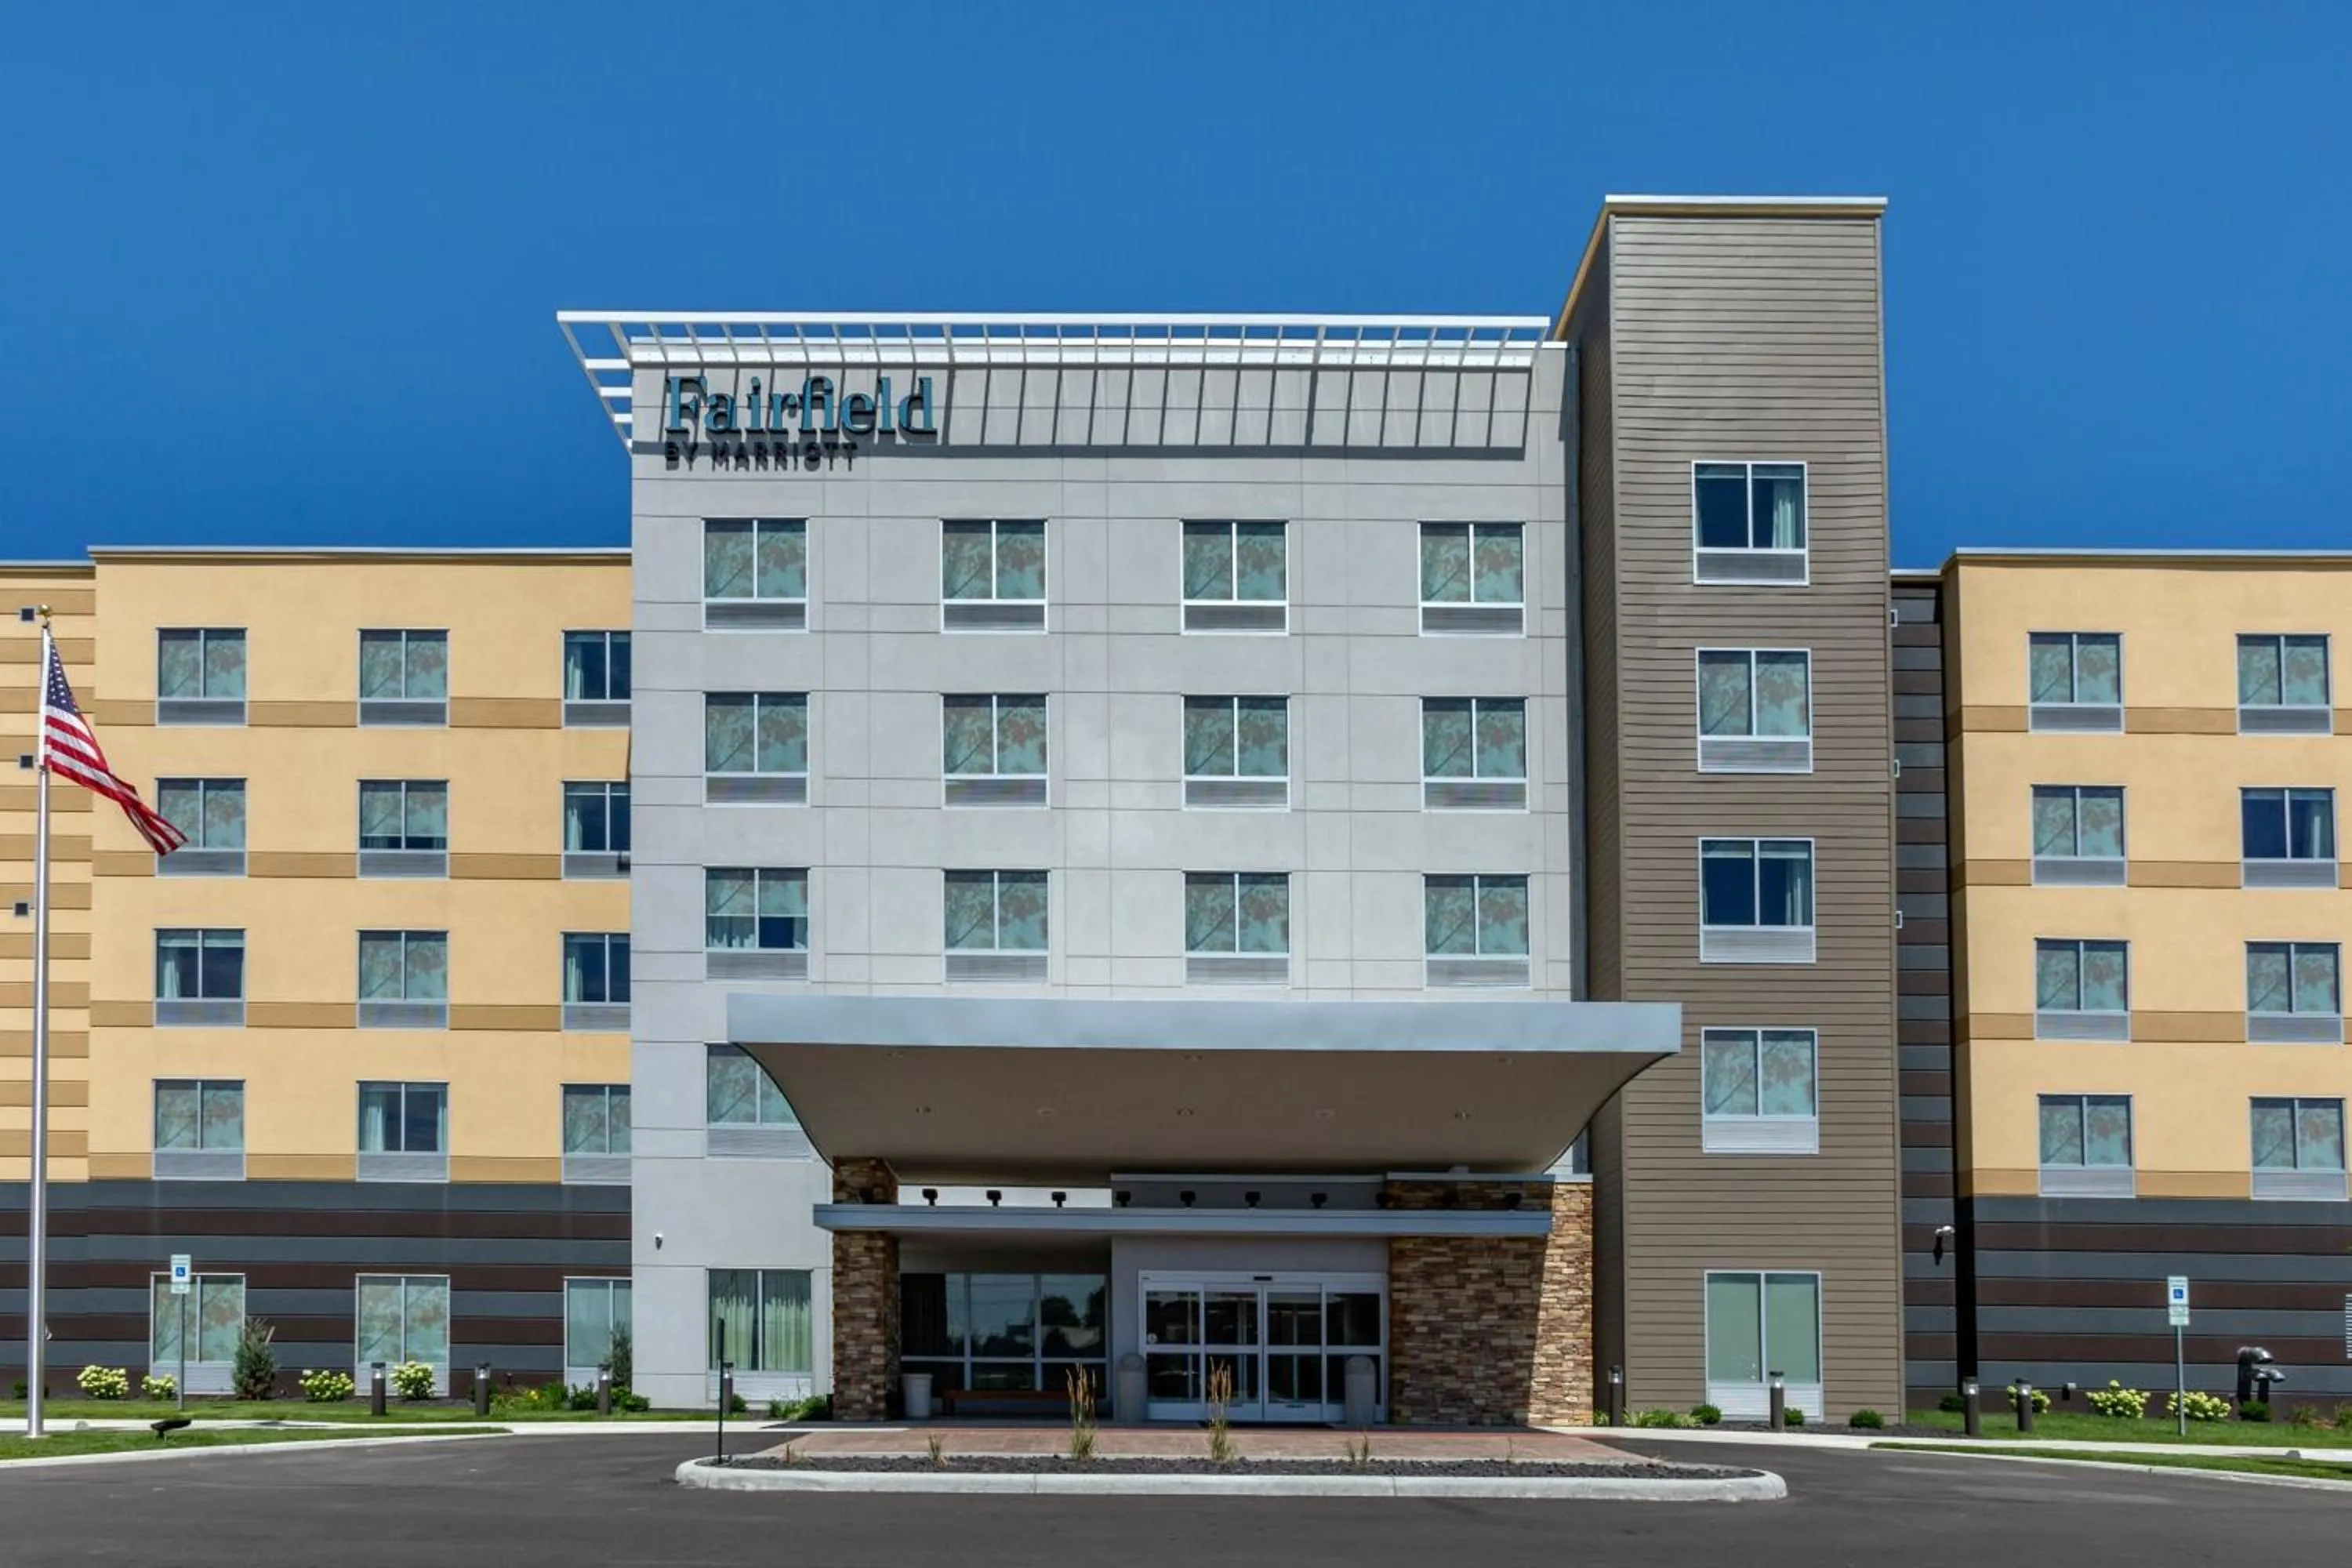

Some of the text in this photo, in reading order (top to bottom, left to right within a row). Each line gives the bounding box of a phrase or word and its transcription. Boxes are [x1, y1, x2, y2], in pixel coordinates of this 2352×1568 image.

[665, 376, 937, 434] Fairfield
[665, 441, 858, 468] BY MARRIOTT
